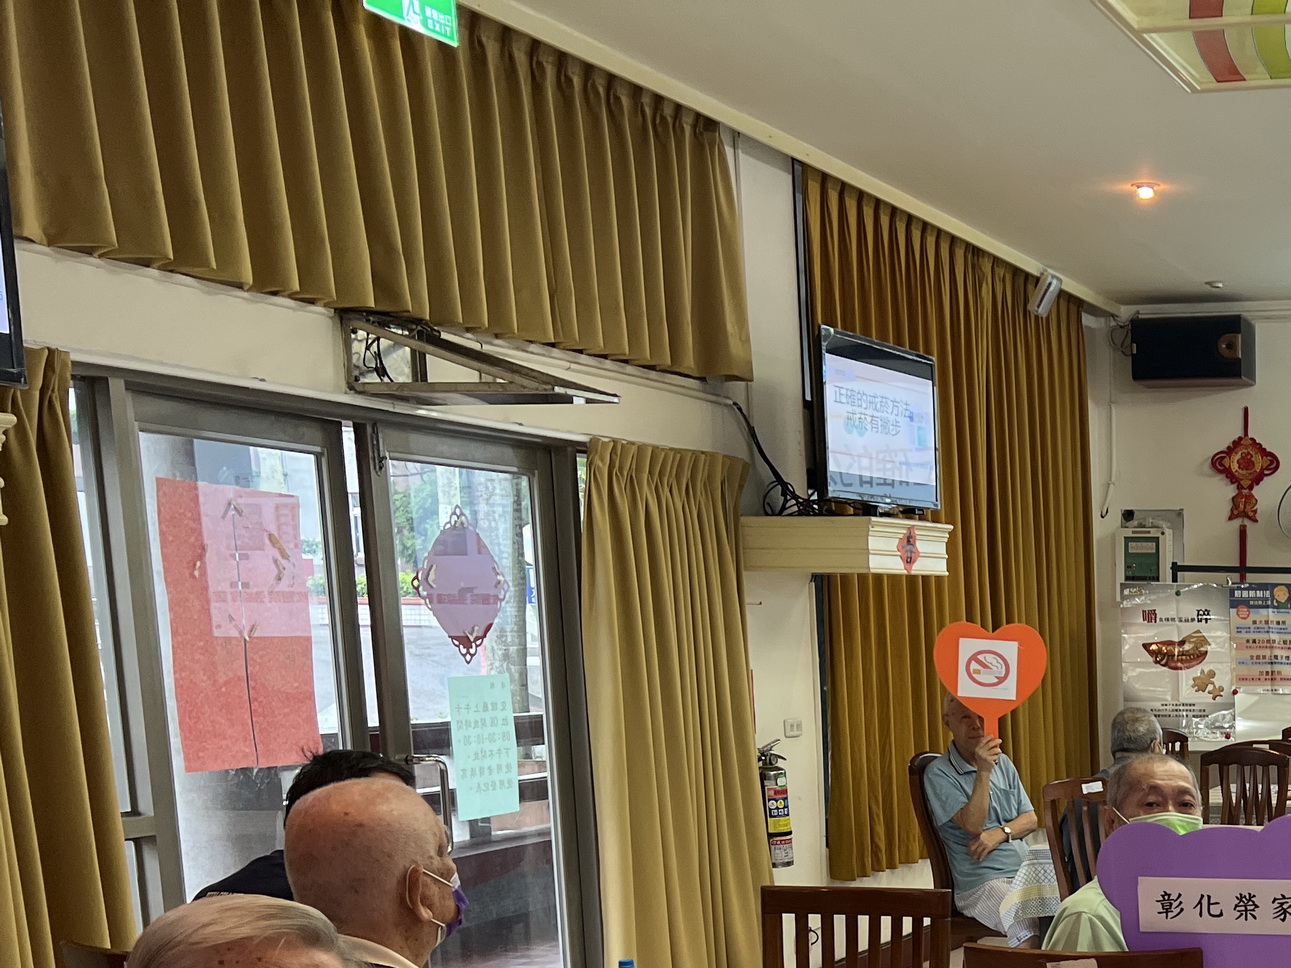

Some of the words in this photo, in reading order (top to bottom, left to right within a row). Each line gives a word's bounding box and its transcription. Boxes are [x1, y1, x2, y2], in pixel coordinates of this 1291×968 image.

[427, 18, 451, 37] EXIT
[833, 384, 913, 419] 正確的戒菸方法
[845, 410, 901, 437] 戒菸有撇步
